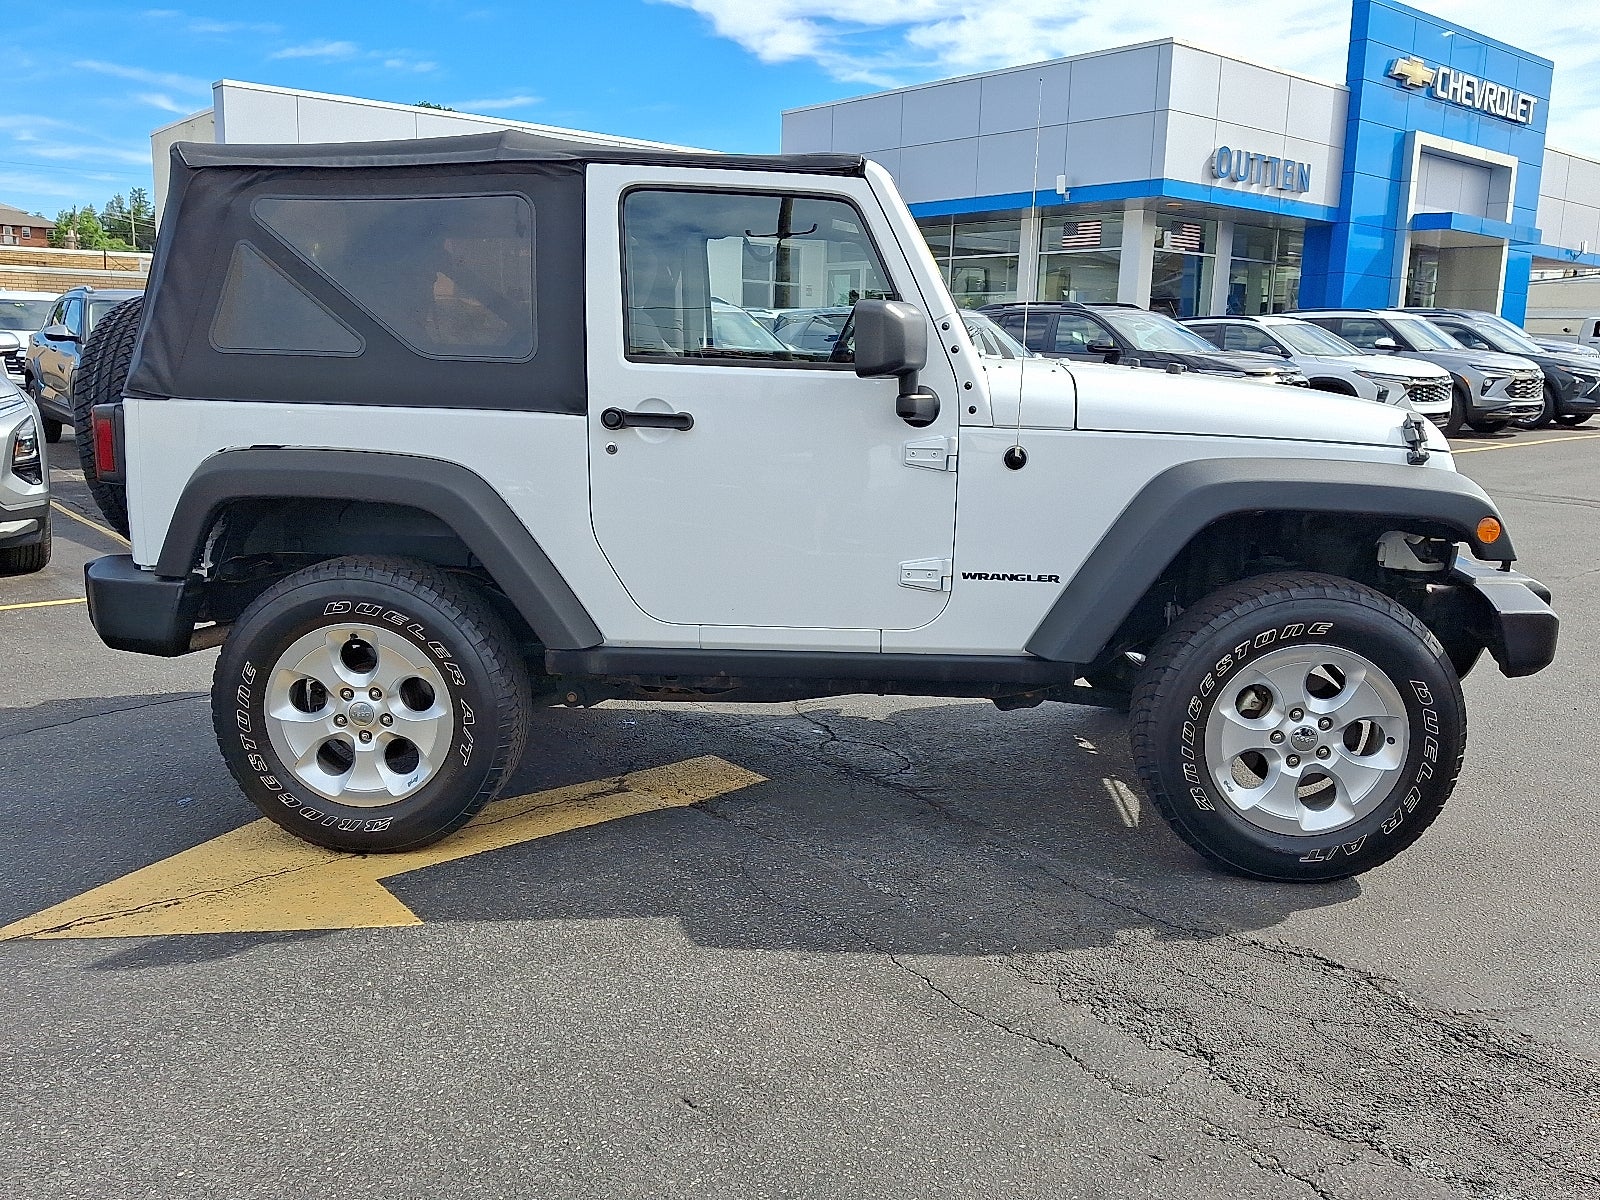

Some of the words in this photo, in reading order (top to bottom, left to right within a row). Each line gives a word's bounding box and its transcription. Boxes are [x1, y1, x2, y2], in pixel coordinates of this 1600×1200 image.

[1436, 66, 1538, 125] CHEVROLET
[1212, 146, 1312, 193] OUTTEN
[961, 572, 1061, 584] WRANGLER
[323, 601, 466, 686] DUELER
[459, 698, 477, 767] A/T
[1181, 622, 1335, 812] BRIDGESTONE
[235, 661, 394, 833] BRIDGESTONE
[1381, 679, 1441, 835] DUELER
[1299, 833, 1369, 863] A/T
